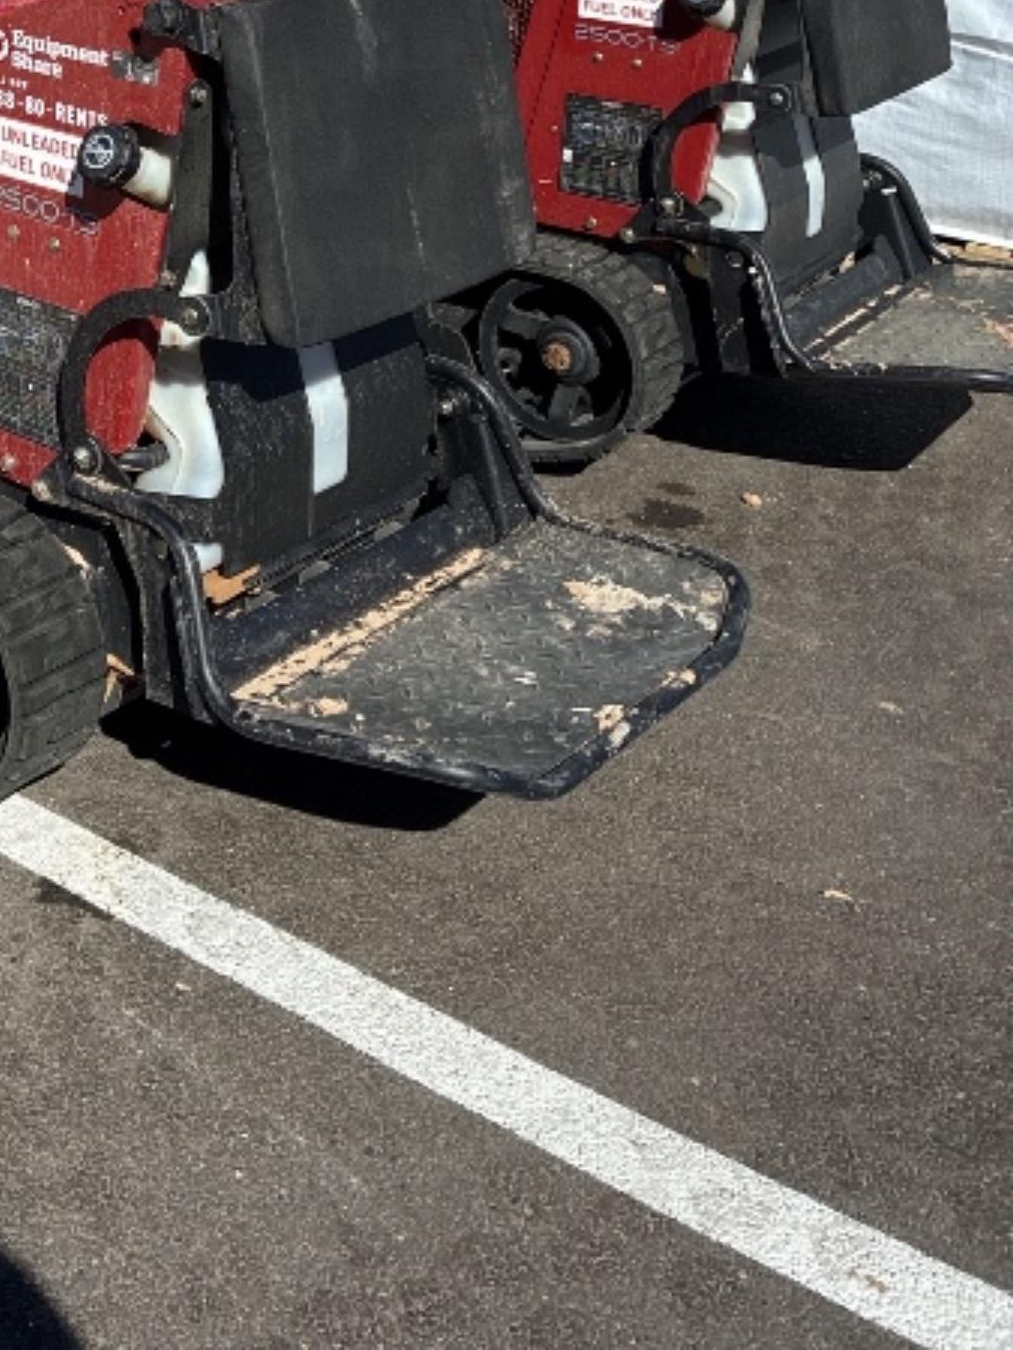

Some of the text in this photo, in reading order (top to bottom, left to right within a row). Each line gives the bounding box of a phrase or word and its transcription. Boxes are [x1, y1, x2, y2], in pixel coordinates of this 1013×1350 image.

[11, 29, 109, 67] Equipment
[10, 49, 63, 79] Share
[0, 148, 36, 175] FUEL
